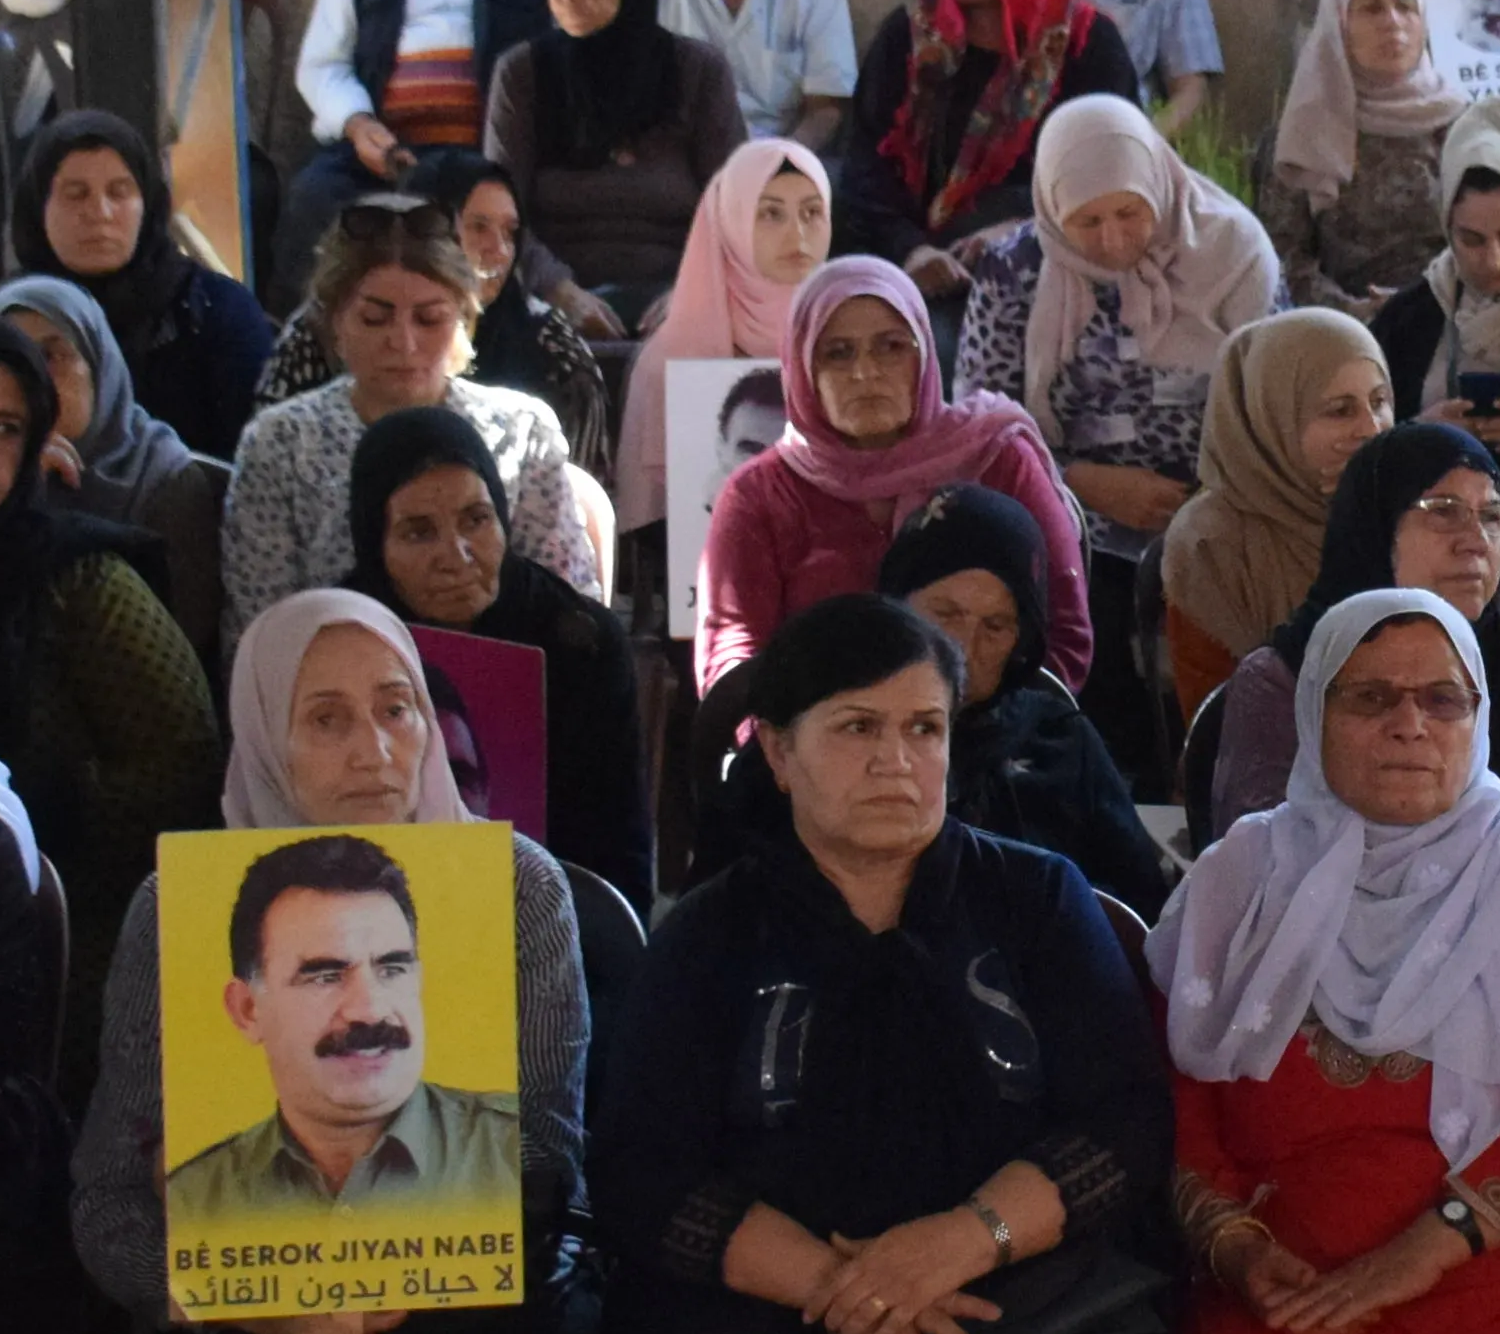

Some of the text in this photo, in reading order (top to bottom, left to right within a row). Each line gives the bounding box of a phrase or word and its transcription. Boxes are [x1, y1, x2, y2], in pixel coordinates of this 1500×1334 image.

[1459, 61, 1490, 83] BÊ
[174, 1233, 515, 1270] BÊ SEROK JIYAN NABE
[184, 1263, 514, 1308] لا حياة بدون القائد
